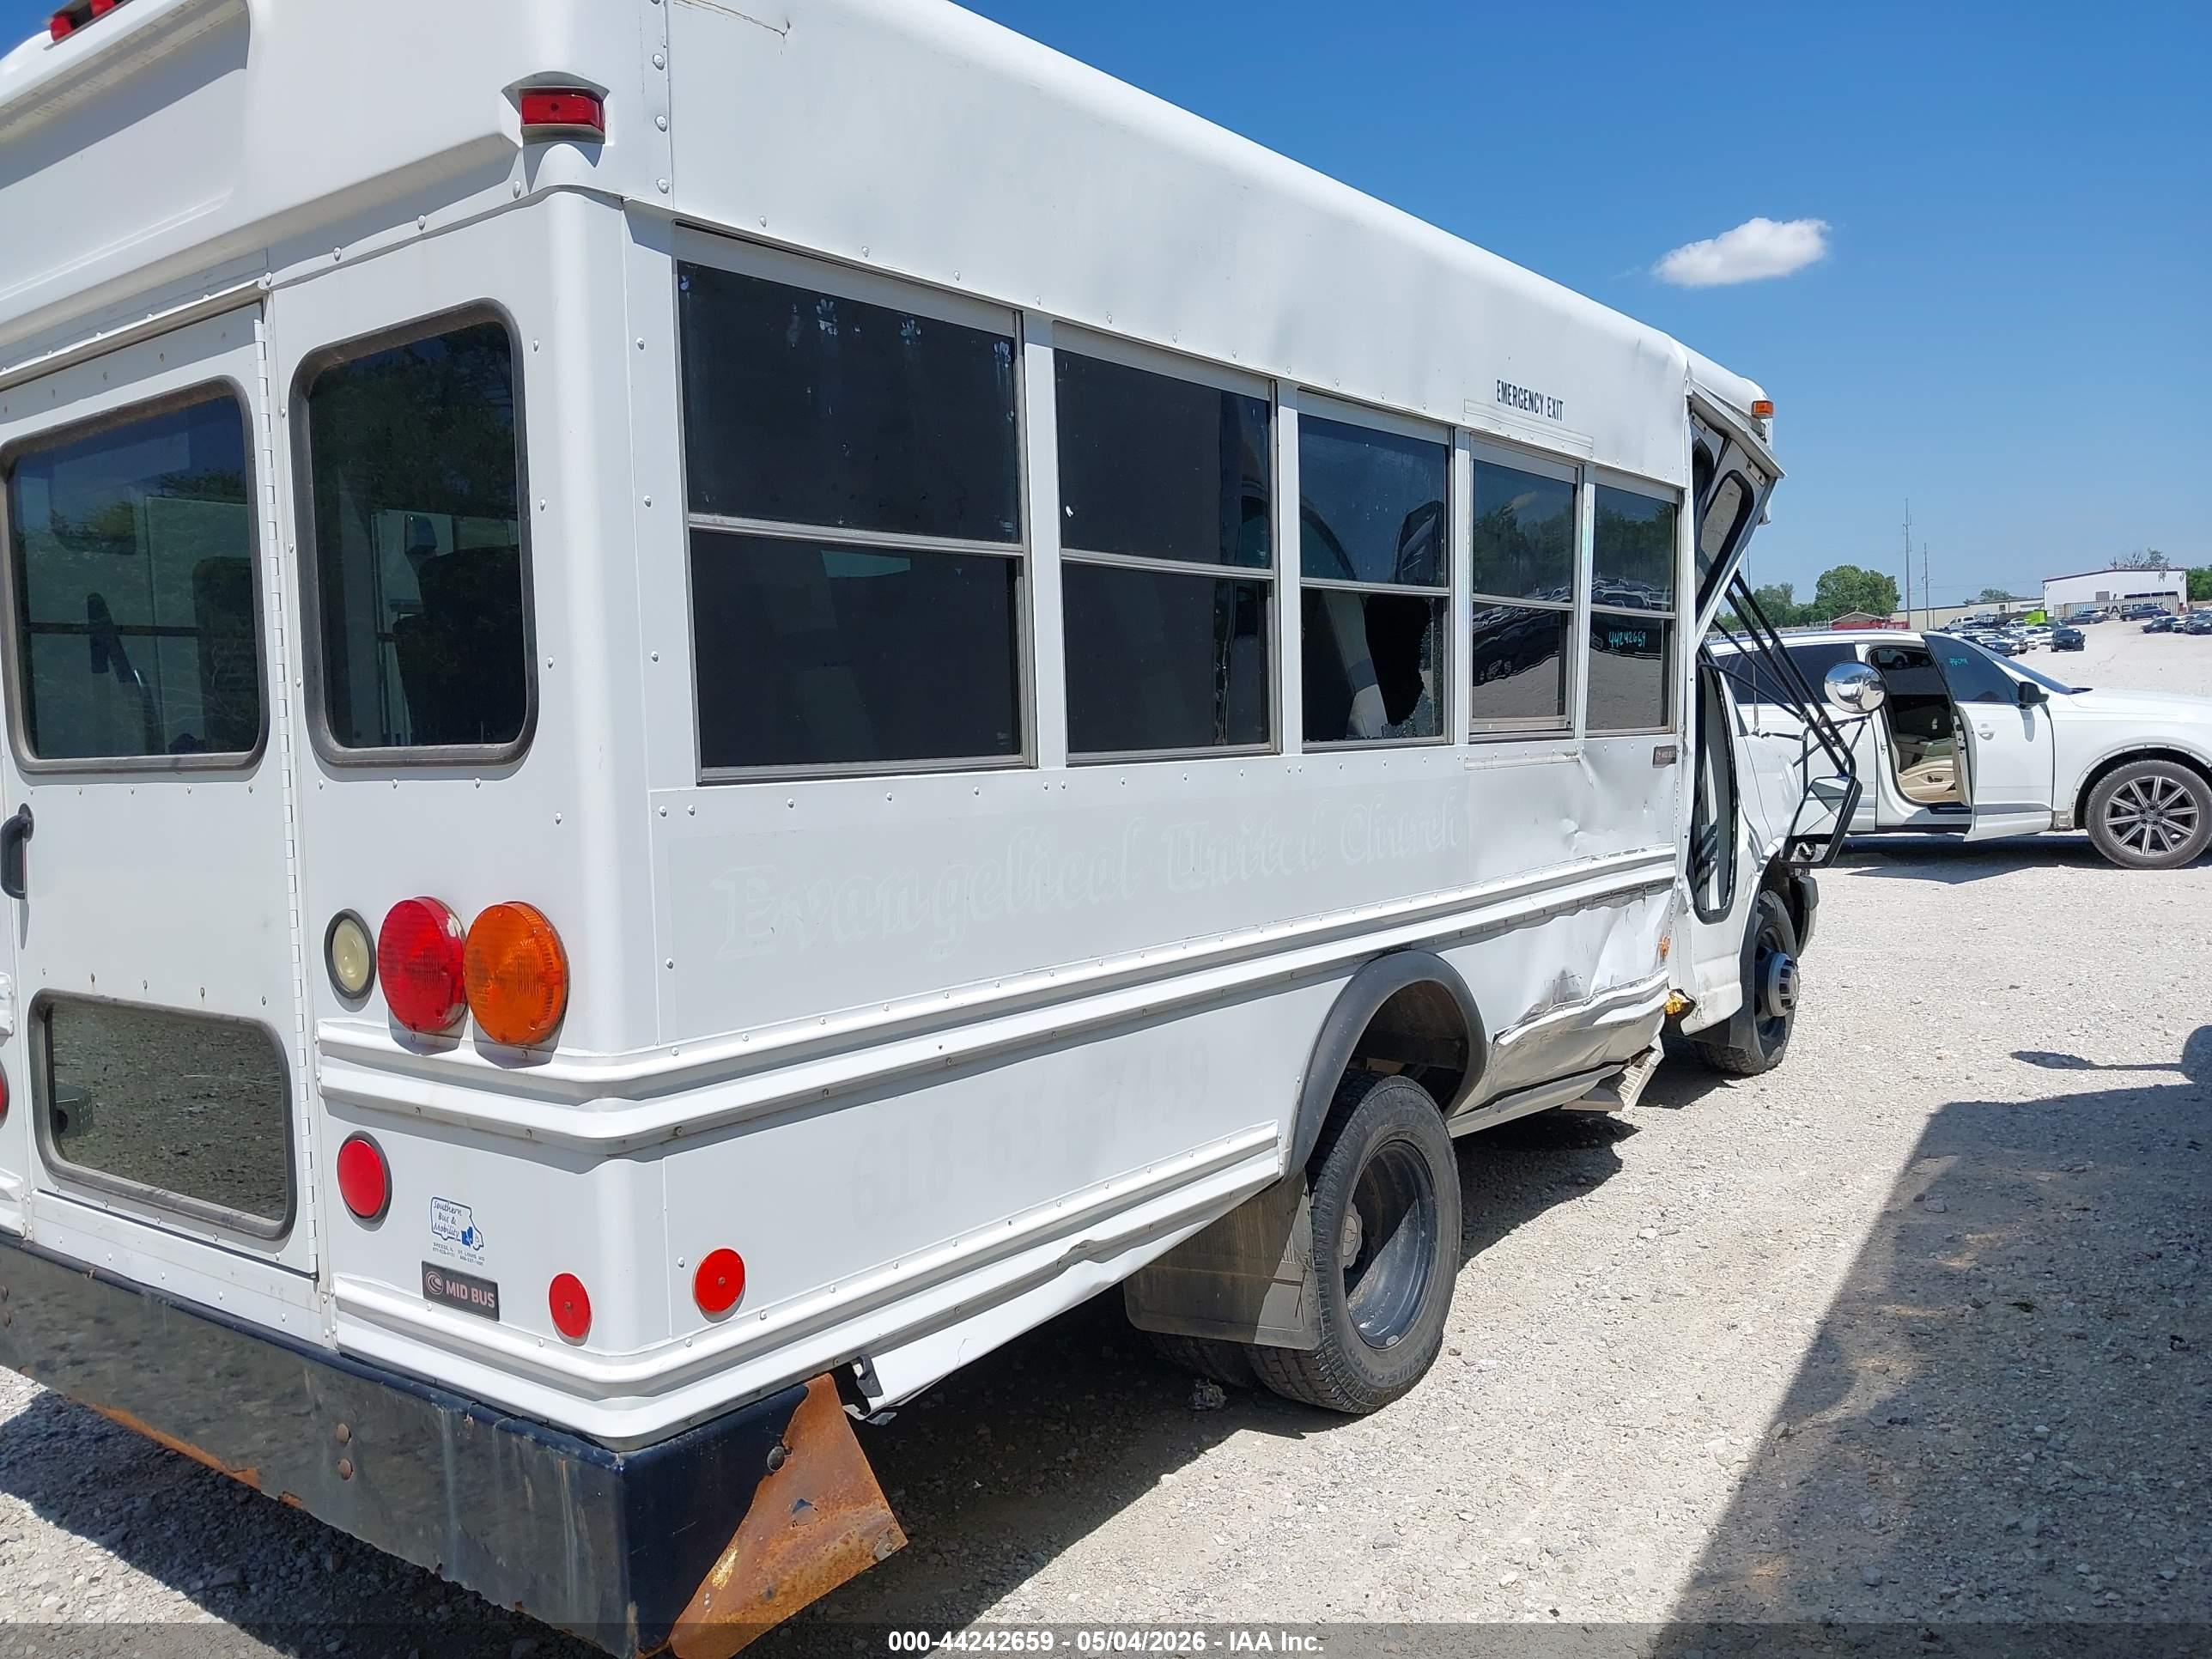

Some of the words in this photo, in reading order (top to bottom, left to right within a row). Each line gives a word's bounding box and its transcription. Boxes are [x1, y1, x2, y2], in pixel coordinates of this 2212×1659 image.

[1496, 379, 1545, 416] EMERGENCY
[1547, 396, 1564, 422] EXIT
[1608, 630, 1646, 649] 44242659
[433, 1200, 462, 1217] Southern
[438, 1212, 449, 1224] Bus
[451, 1216, 457, 1225] &
[433, 1222, 459, 1241] Mobility
[446, 1279, 468, 1300] MID
[471, 1287, 495, 1309] BUS
